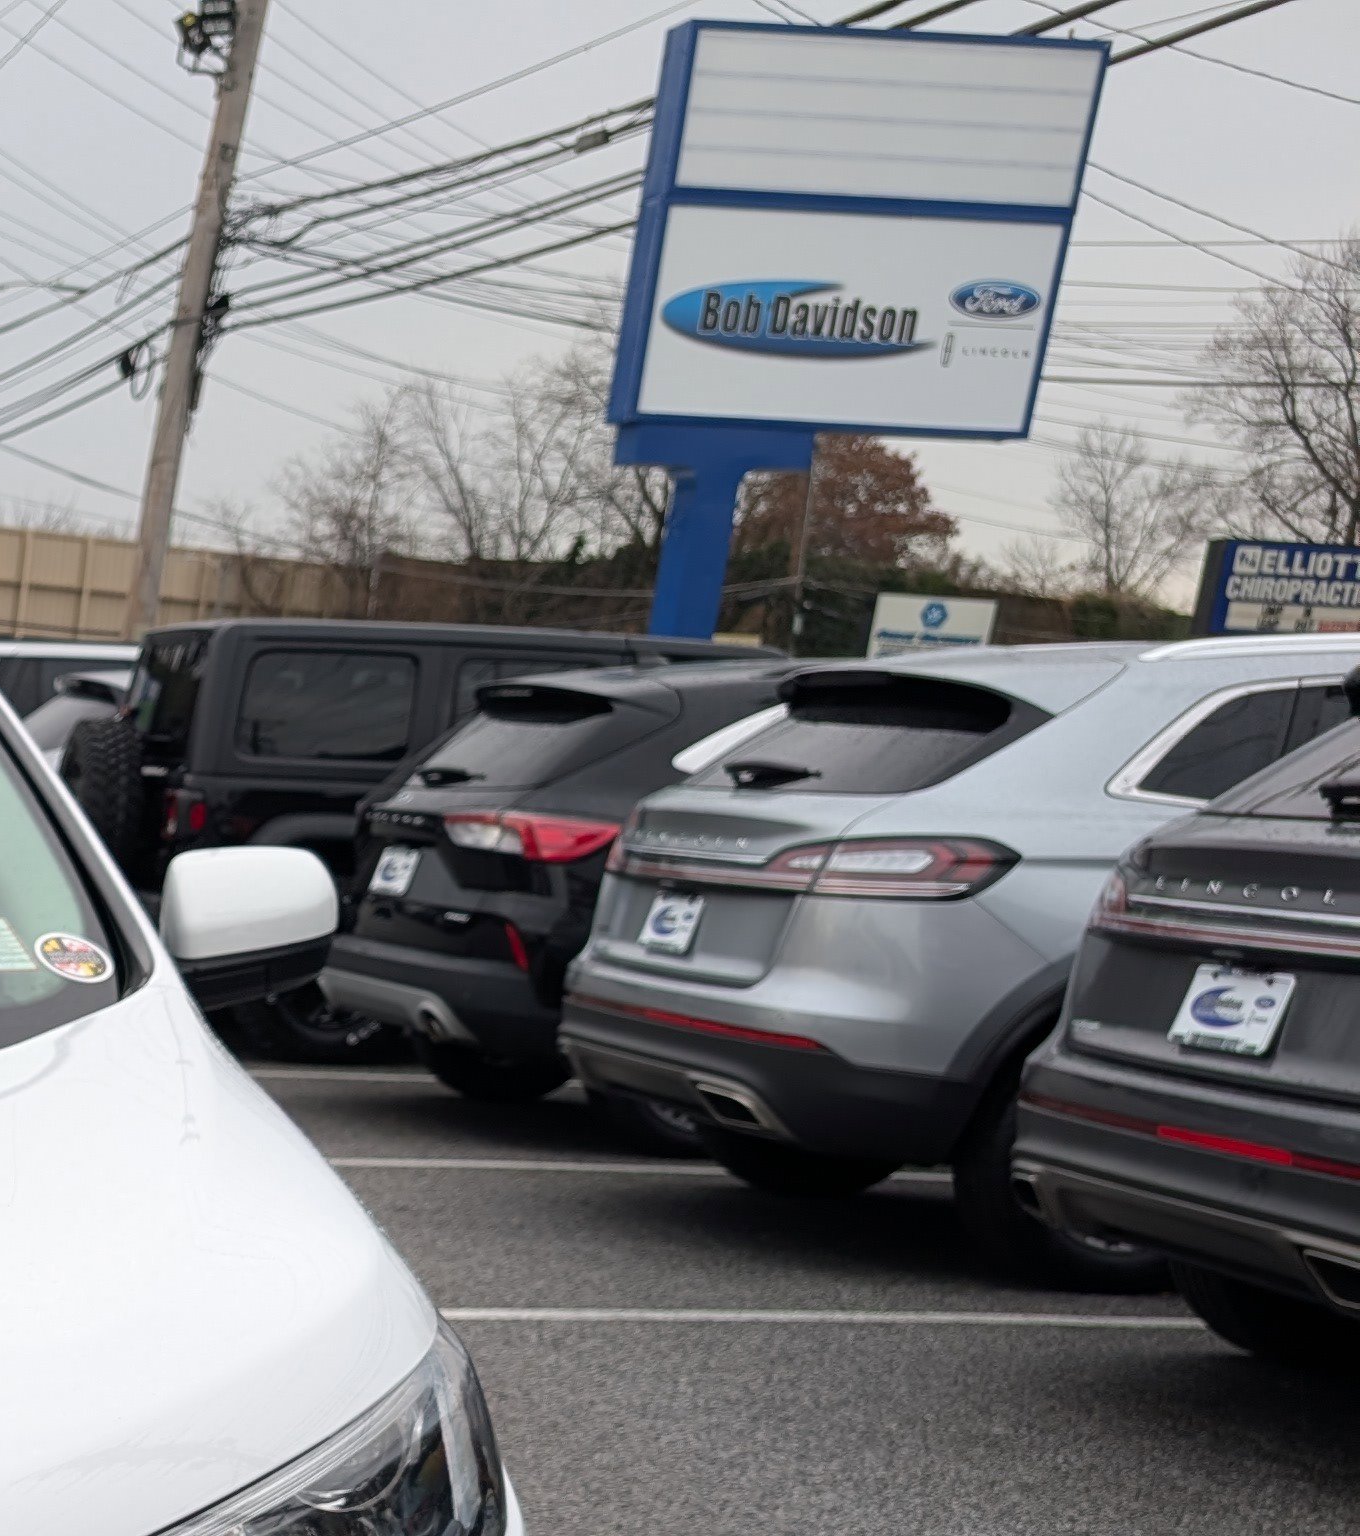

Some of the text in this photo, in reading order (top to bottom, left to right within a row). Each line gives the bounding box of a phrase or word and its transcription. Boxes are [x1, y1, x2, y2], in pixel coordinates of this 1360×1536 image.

[697, 289, 919, 345] Bob Davidson
[964, 286, 1026, 314] Ford
